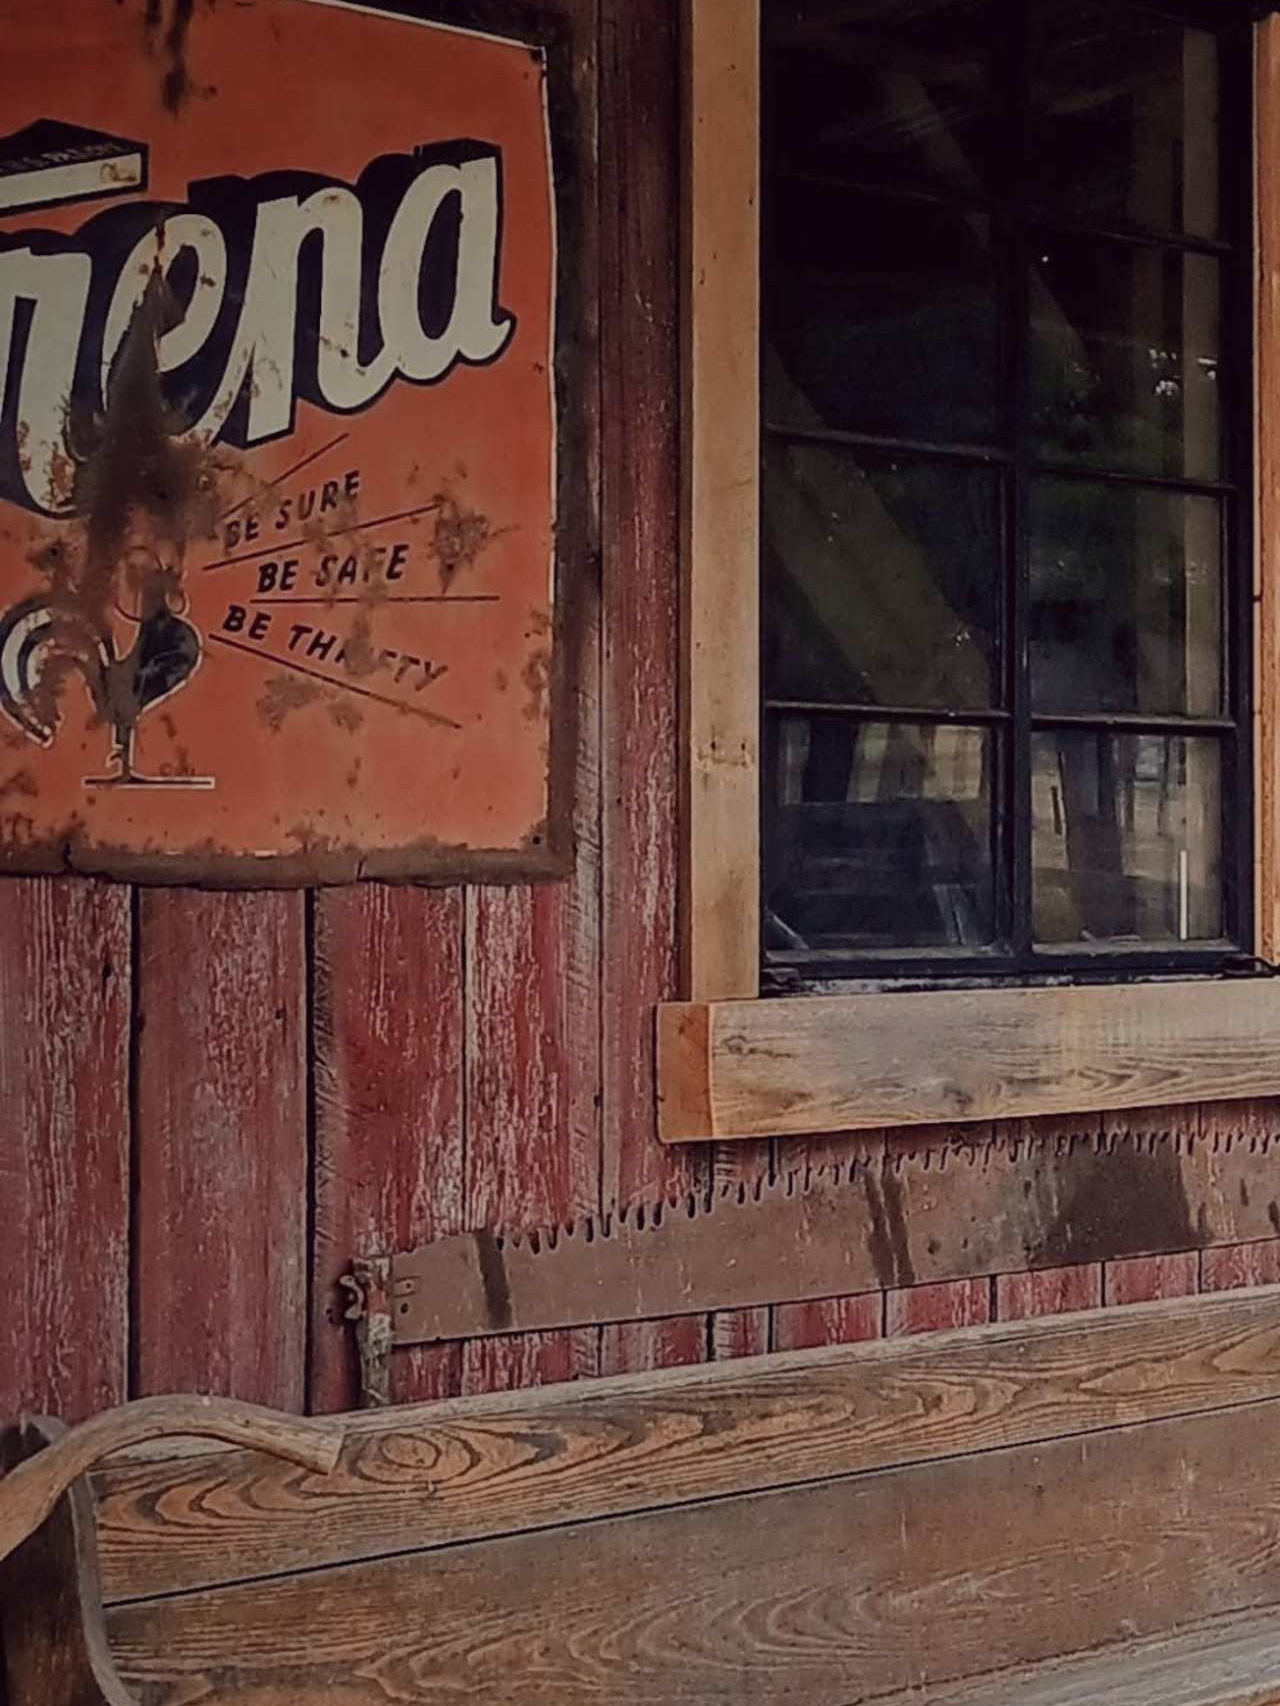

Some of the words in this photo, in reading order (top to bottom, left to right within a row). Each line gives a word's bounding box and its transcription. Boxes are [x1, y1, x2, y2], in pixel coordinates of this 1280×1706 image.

[223, 512, 260, 550] BE
[275, 470, 359, 530] SURE
[257, 560, 299, 593] BE
[315, 544, 409, 587] SAFE
[222, 604, 272, 640] BE
[287, 624, 449, 692] THFTY
